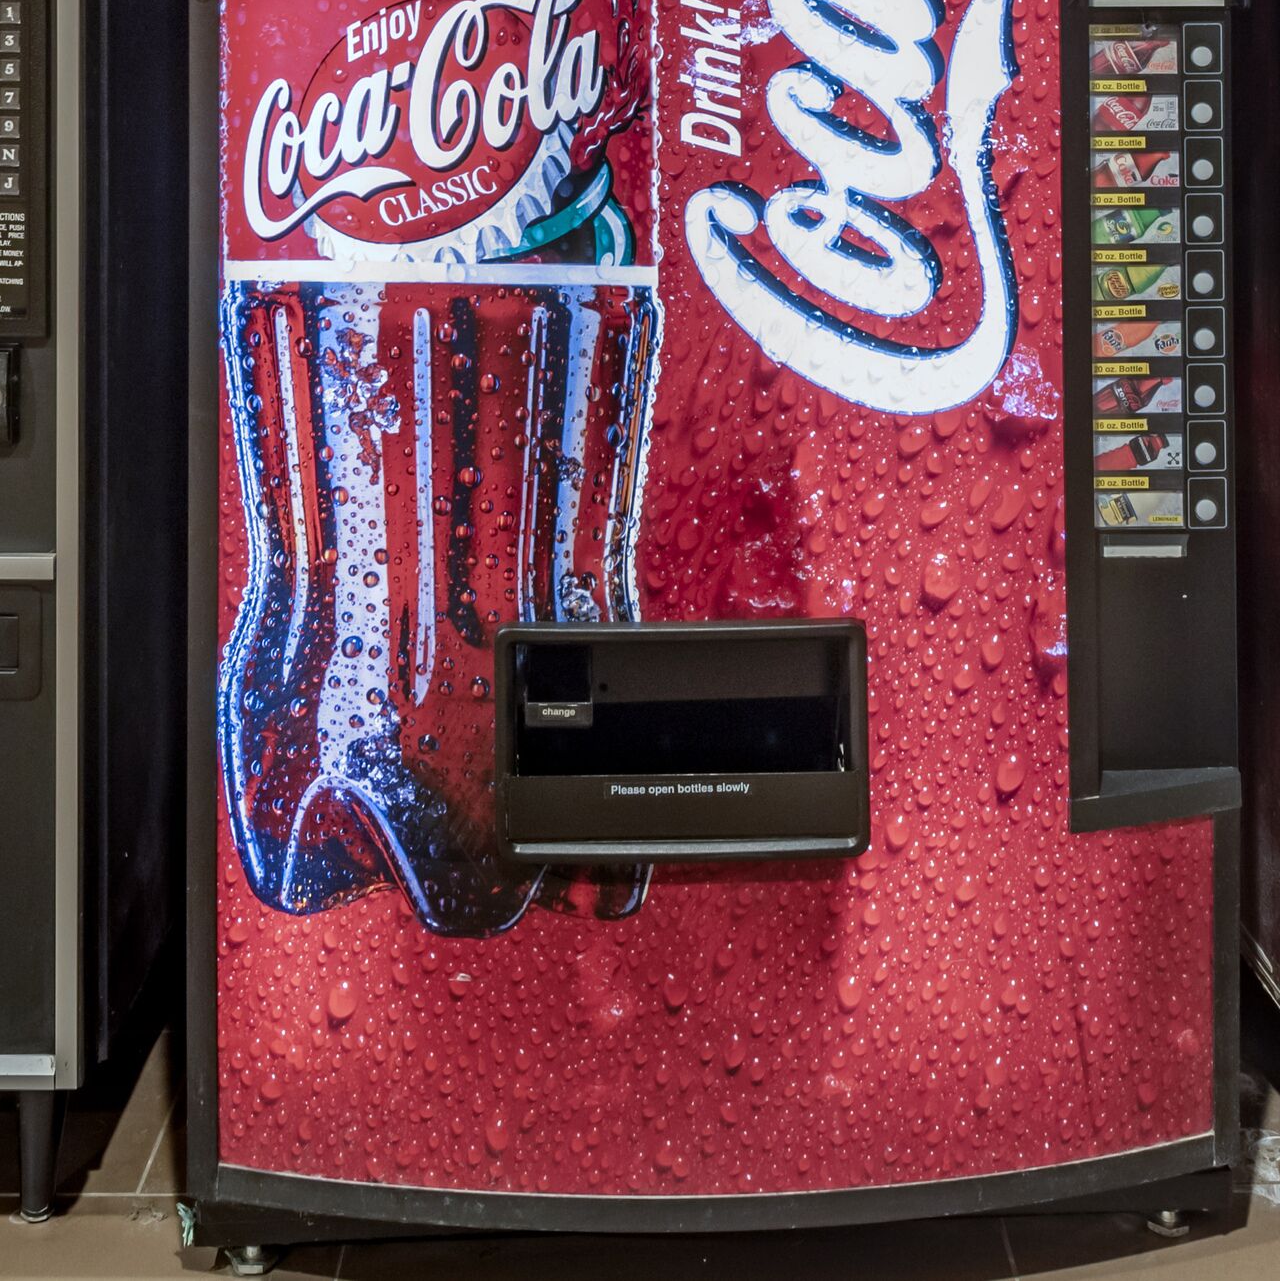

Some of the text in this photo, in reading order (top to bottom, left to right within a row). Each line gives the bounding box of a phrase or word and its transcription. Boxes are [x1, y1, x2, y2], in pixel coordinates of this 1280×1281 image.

[5, 6, 13, 18] 1
[4, 34, 15, 46] 3
[4, 63, 14, 75] 5
[4, 91, 15, 103] 7
[4, 120, 14, 132] 9
[1118, 139, 1142, 147] Bottle
[2, 148, 16, 160] N
[4, 177, 14, 189] J
[1150, 174, 1178, 186] Coke
[378, 164, 500, 227] CLASSIC
[1117, 195, 1142, 203] Bottle
[1118, 252, 1143, 260] Bottle
[1154, 336, 1179, 350] Fanta
[1119, 365, 1143, 373] Bottle
[1120, 421, 1144, 429] Bottle
[1121, 479, 1145, 487] Bottle
[542, 707, 576, 717] change
[610, 782, 750, 796] Please open bottles slowly
